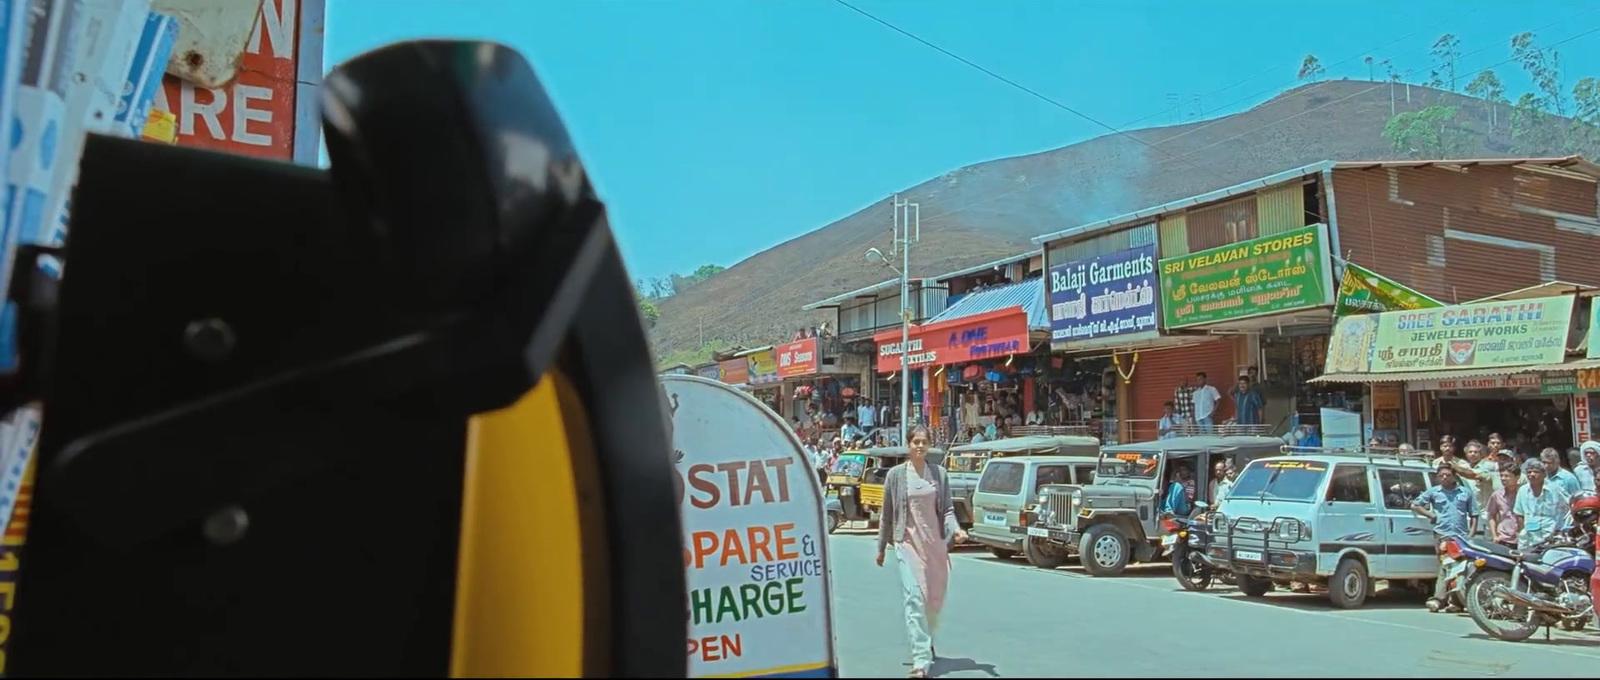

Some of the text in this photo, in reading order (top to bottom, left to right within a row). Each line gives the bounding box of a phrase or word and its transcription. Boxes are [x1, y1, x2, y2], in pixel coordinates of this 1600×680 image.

[1164, 260, 1185, 274] SRI
[1188, 245, 1249, 269] VELAVAN
[1253, 231, 1314, 256] STORES
[1051, 252, 1154, 294] Balaji Garments
[1398, 312, 1436, 330] SREE
[1441, 302, 1544, 327] SARATHI
[1410, 328, 1482, 342] JEWELLERY
[1484, 324, 1528, 337] WORKS
[1398, 342, 1443, 358] சாரதி
[1462, 378, 1497, 388] SARATHI
[682, 522, 816, 570] PARE &
[750, 558, 822, 582] SERVICE
